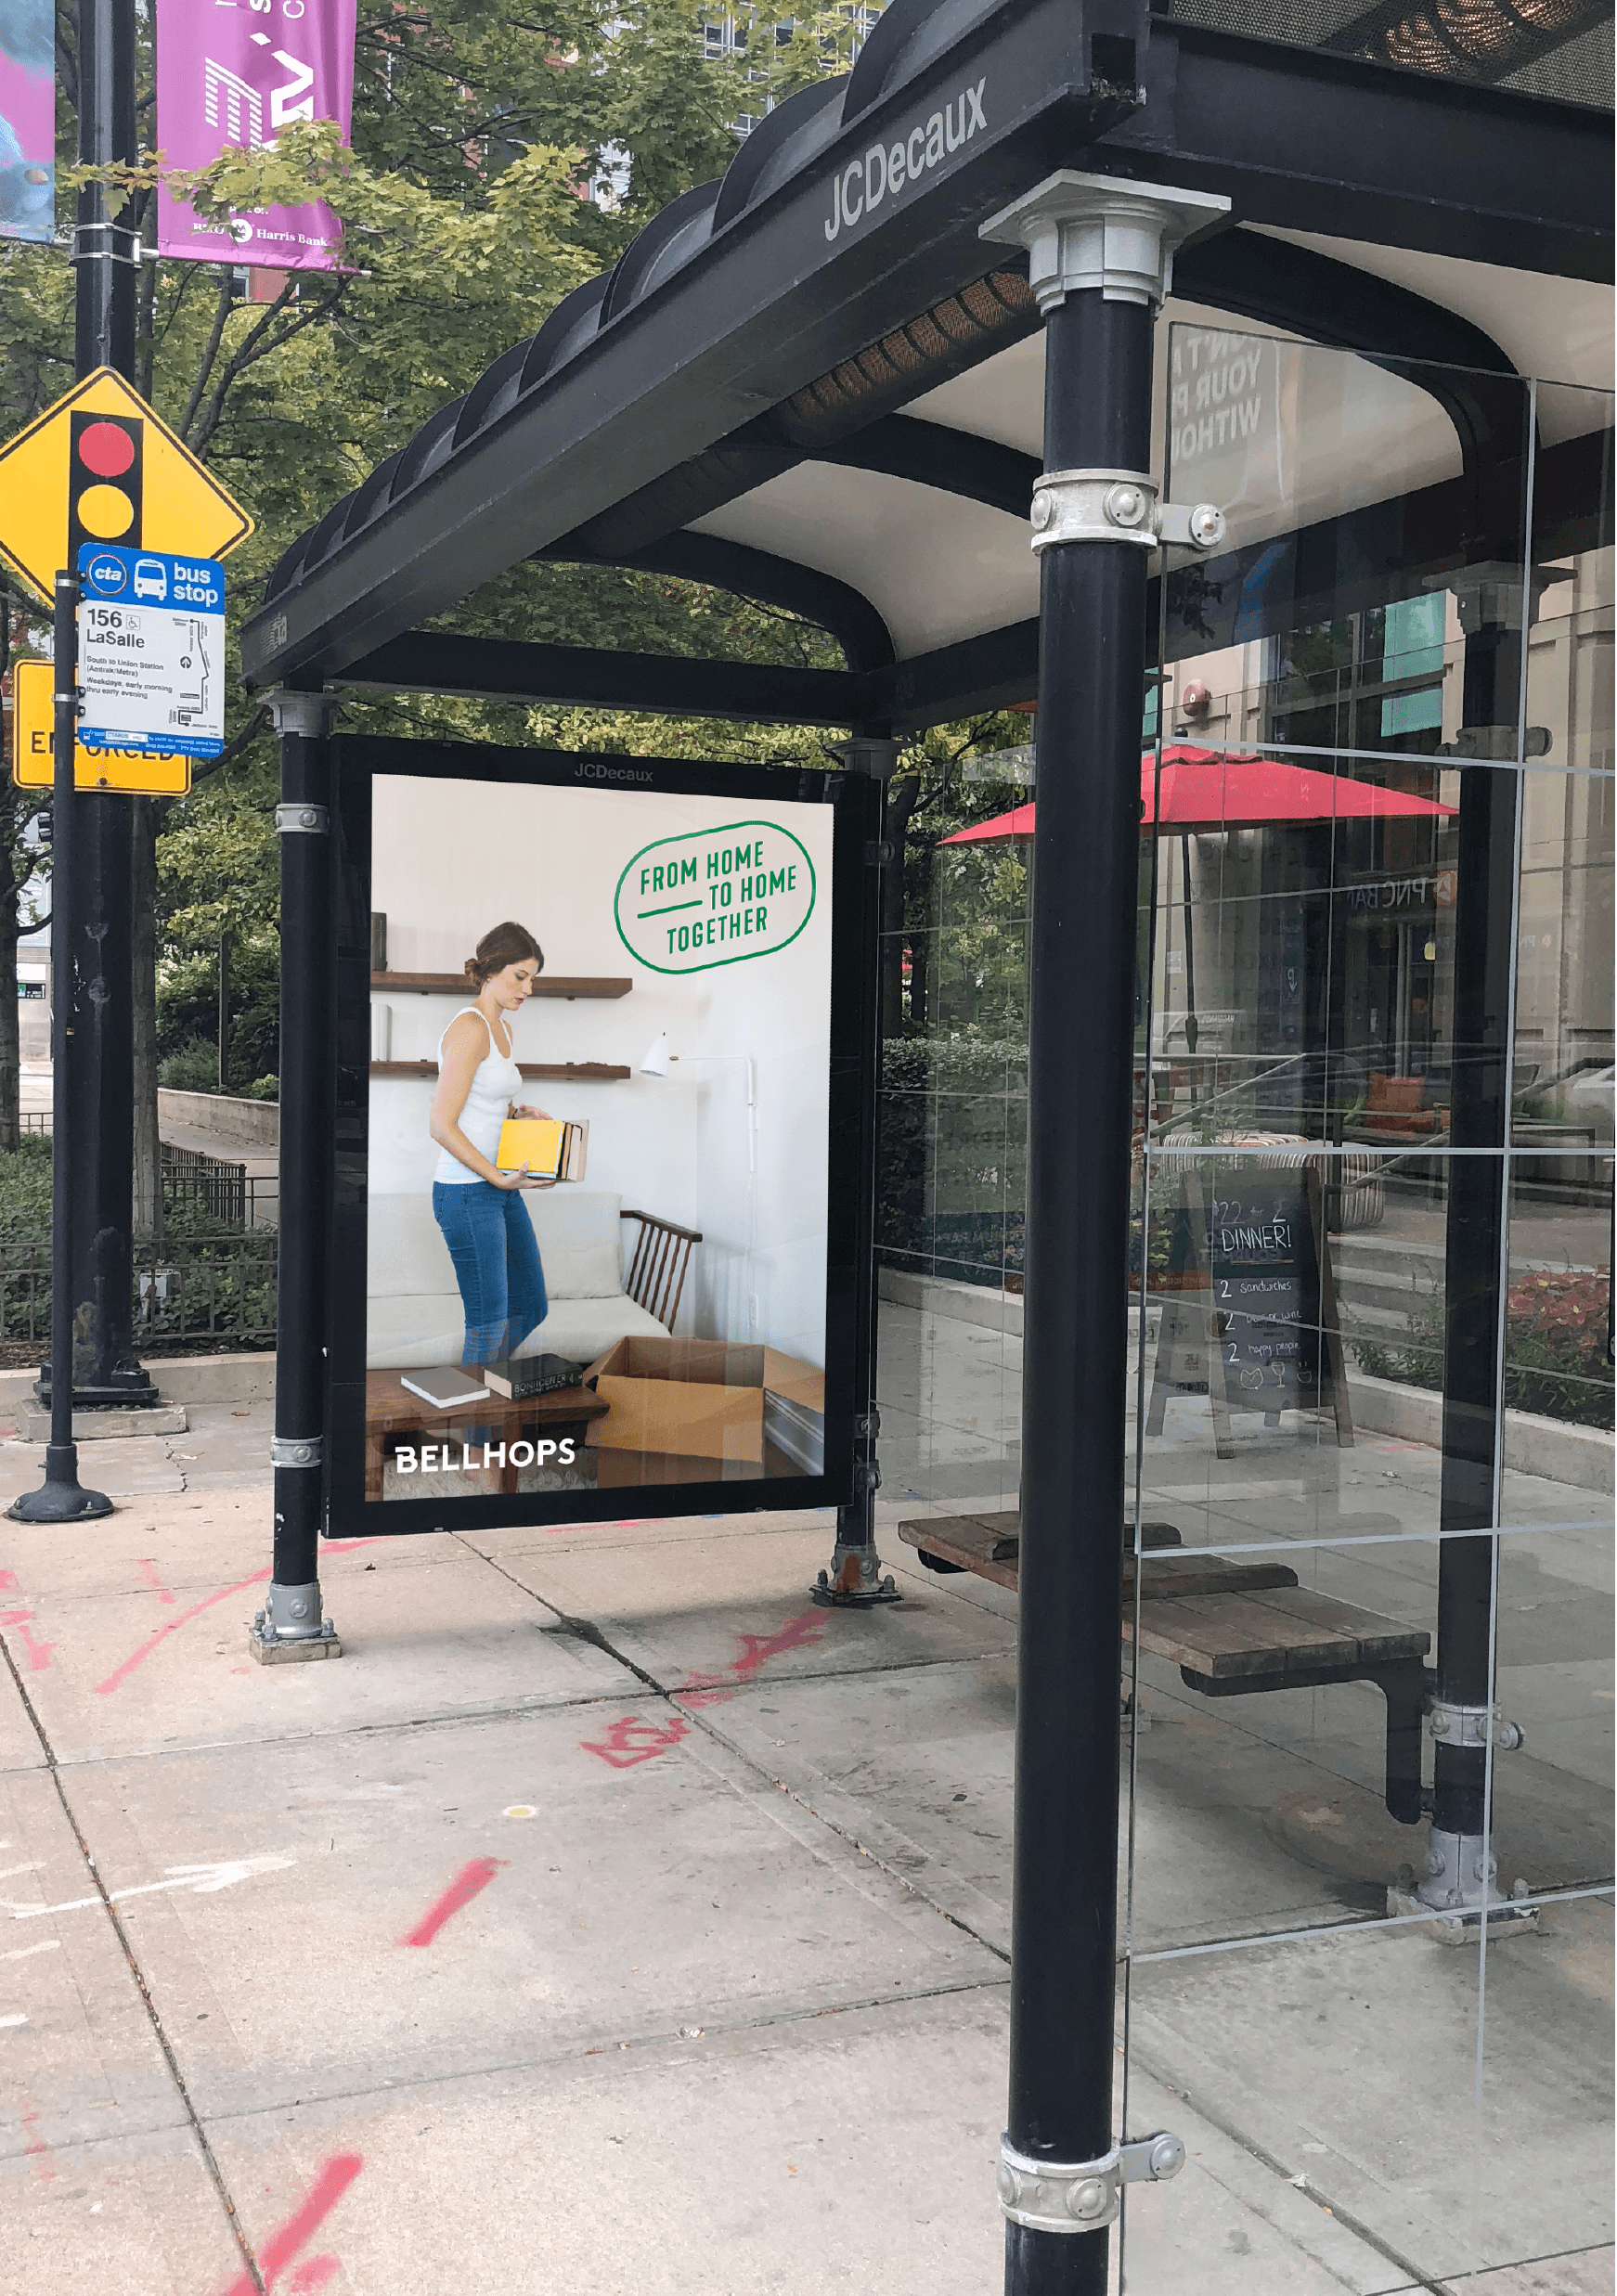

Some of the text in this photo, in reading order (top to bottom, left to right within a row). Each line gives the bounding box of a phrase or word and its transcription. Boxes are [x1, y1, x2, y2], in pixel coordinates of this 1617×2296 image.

[824, 76, 989, 241] JCDecaux
[257, 228, 328, 246] Harris Bank
[95, 567, 123, 583] cta
[174, 562, 212, 585] bus
[174, 585, 219, 608] stop
[87, 609, 123, 628] 156
[86, 628, 146, 649] LaSalle
[86, 655, 107, 664] South
[118, 659, 138, 667] Union
[139, 662, 164, 671] Station
[86, 686, 149, 700] thru early evening
[125, 681, 143, 690] early
[144, 684, 173, 694] morning
[575, 763, 654, 782] JCDecaux
[640, 841, 765, 896] FROM HOME
[709, 864, 797, 910] TO HOME
[666, 906, 769, 955] TOGETHER
[1272, 1199, 1287, 1223] 2
[1222, 1225, 1292, 1252] DINNER!
[1220, 1280, 1232, 1298] 2
[1223, 1309, 1236, 1331] 2
[1228, 1343, 1240, 1362] 2
[1275, 1340, 1300, 1356] people
[395, 1438, 576, 1474] BELLHOPS
